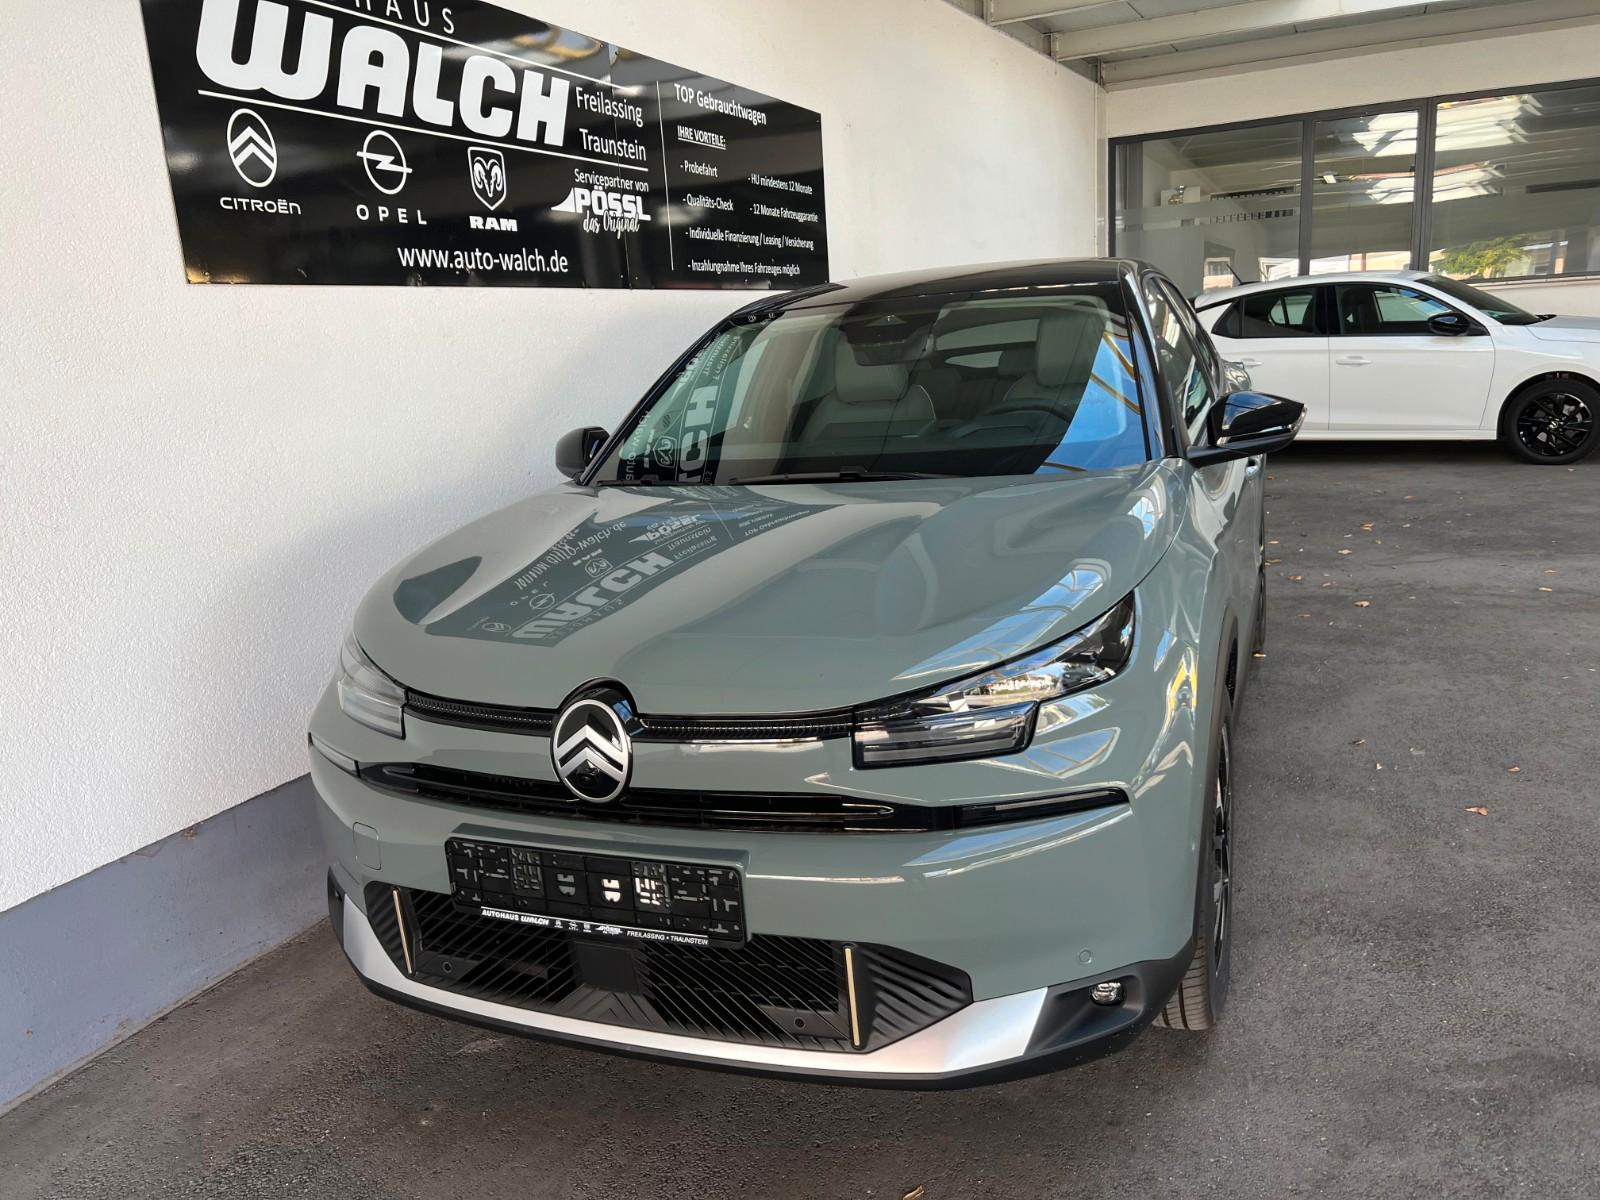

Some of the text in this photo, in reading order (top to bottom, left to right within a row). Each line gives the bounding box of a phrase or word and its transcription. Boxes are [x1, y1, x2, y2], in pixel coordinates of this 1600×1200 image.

[195, 0, 570, 147] WALCH
[575, 86, 644, 128] Freilassing
[674, 83, 766, 126] TOP Gebrauchtwagen
[579, 128, 646, 161] Traunstein
[677, 125, 726, 148] IHRE VORTEILE:
[574, 168, 649, 192] Servicepartner von
[685, 160, 718, 177] Probefahrt
[751, 173, 760, 185] HU
[760, 175, 789, 190] mindestens
[788, 180, 795, 191] 12
[795, 182, 812, 195] Monate
[574, 185, 651, 221] PÖSSL
[687, 193, 733, 211] Qualitäts-Check
[753, 203, 760, 215] 12
[761, 204, 780, 217] Monate
[781, 207, 818, 223] Fahrzeuggarantie
[356, 204, 427, 225] OPEL
[469, 215, 518, 232] RAM
[583, 209, 640, 239] das Original
[689, 226, 724, 241] Individuelle
[725, 230, 759, 246] Finanzierung
[763, 234, 781, 248] Leasing
[785, 236, 814, 251] Versicherung
[398, 247, 568, 273] www.auto-walch.de
[691, 259, 739, 274] Inzahlungnahme
[754, 262, 782, 276] Fahrzeuges
[782, 264, 800, 276] möglich
[482, 909, 519, 921] AUTOHAUS
[521, 915, 549, 926] WALCH
[626, 930, 665, 941] FREILASSING
[670, 935, 708, 945] TRAUNSTEIN
